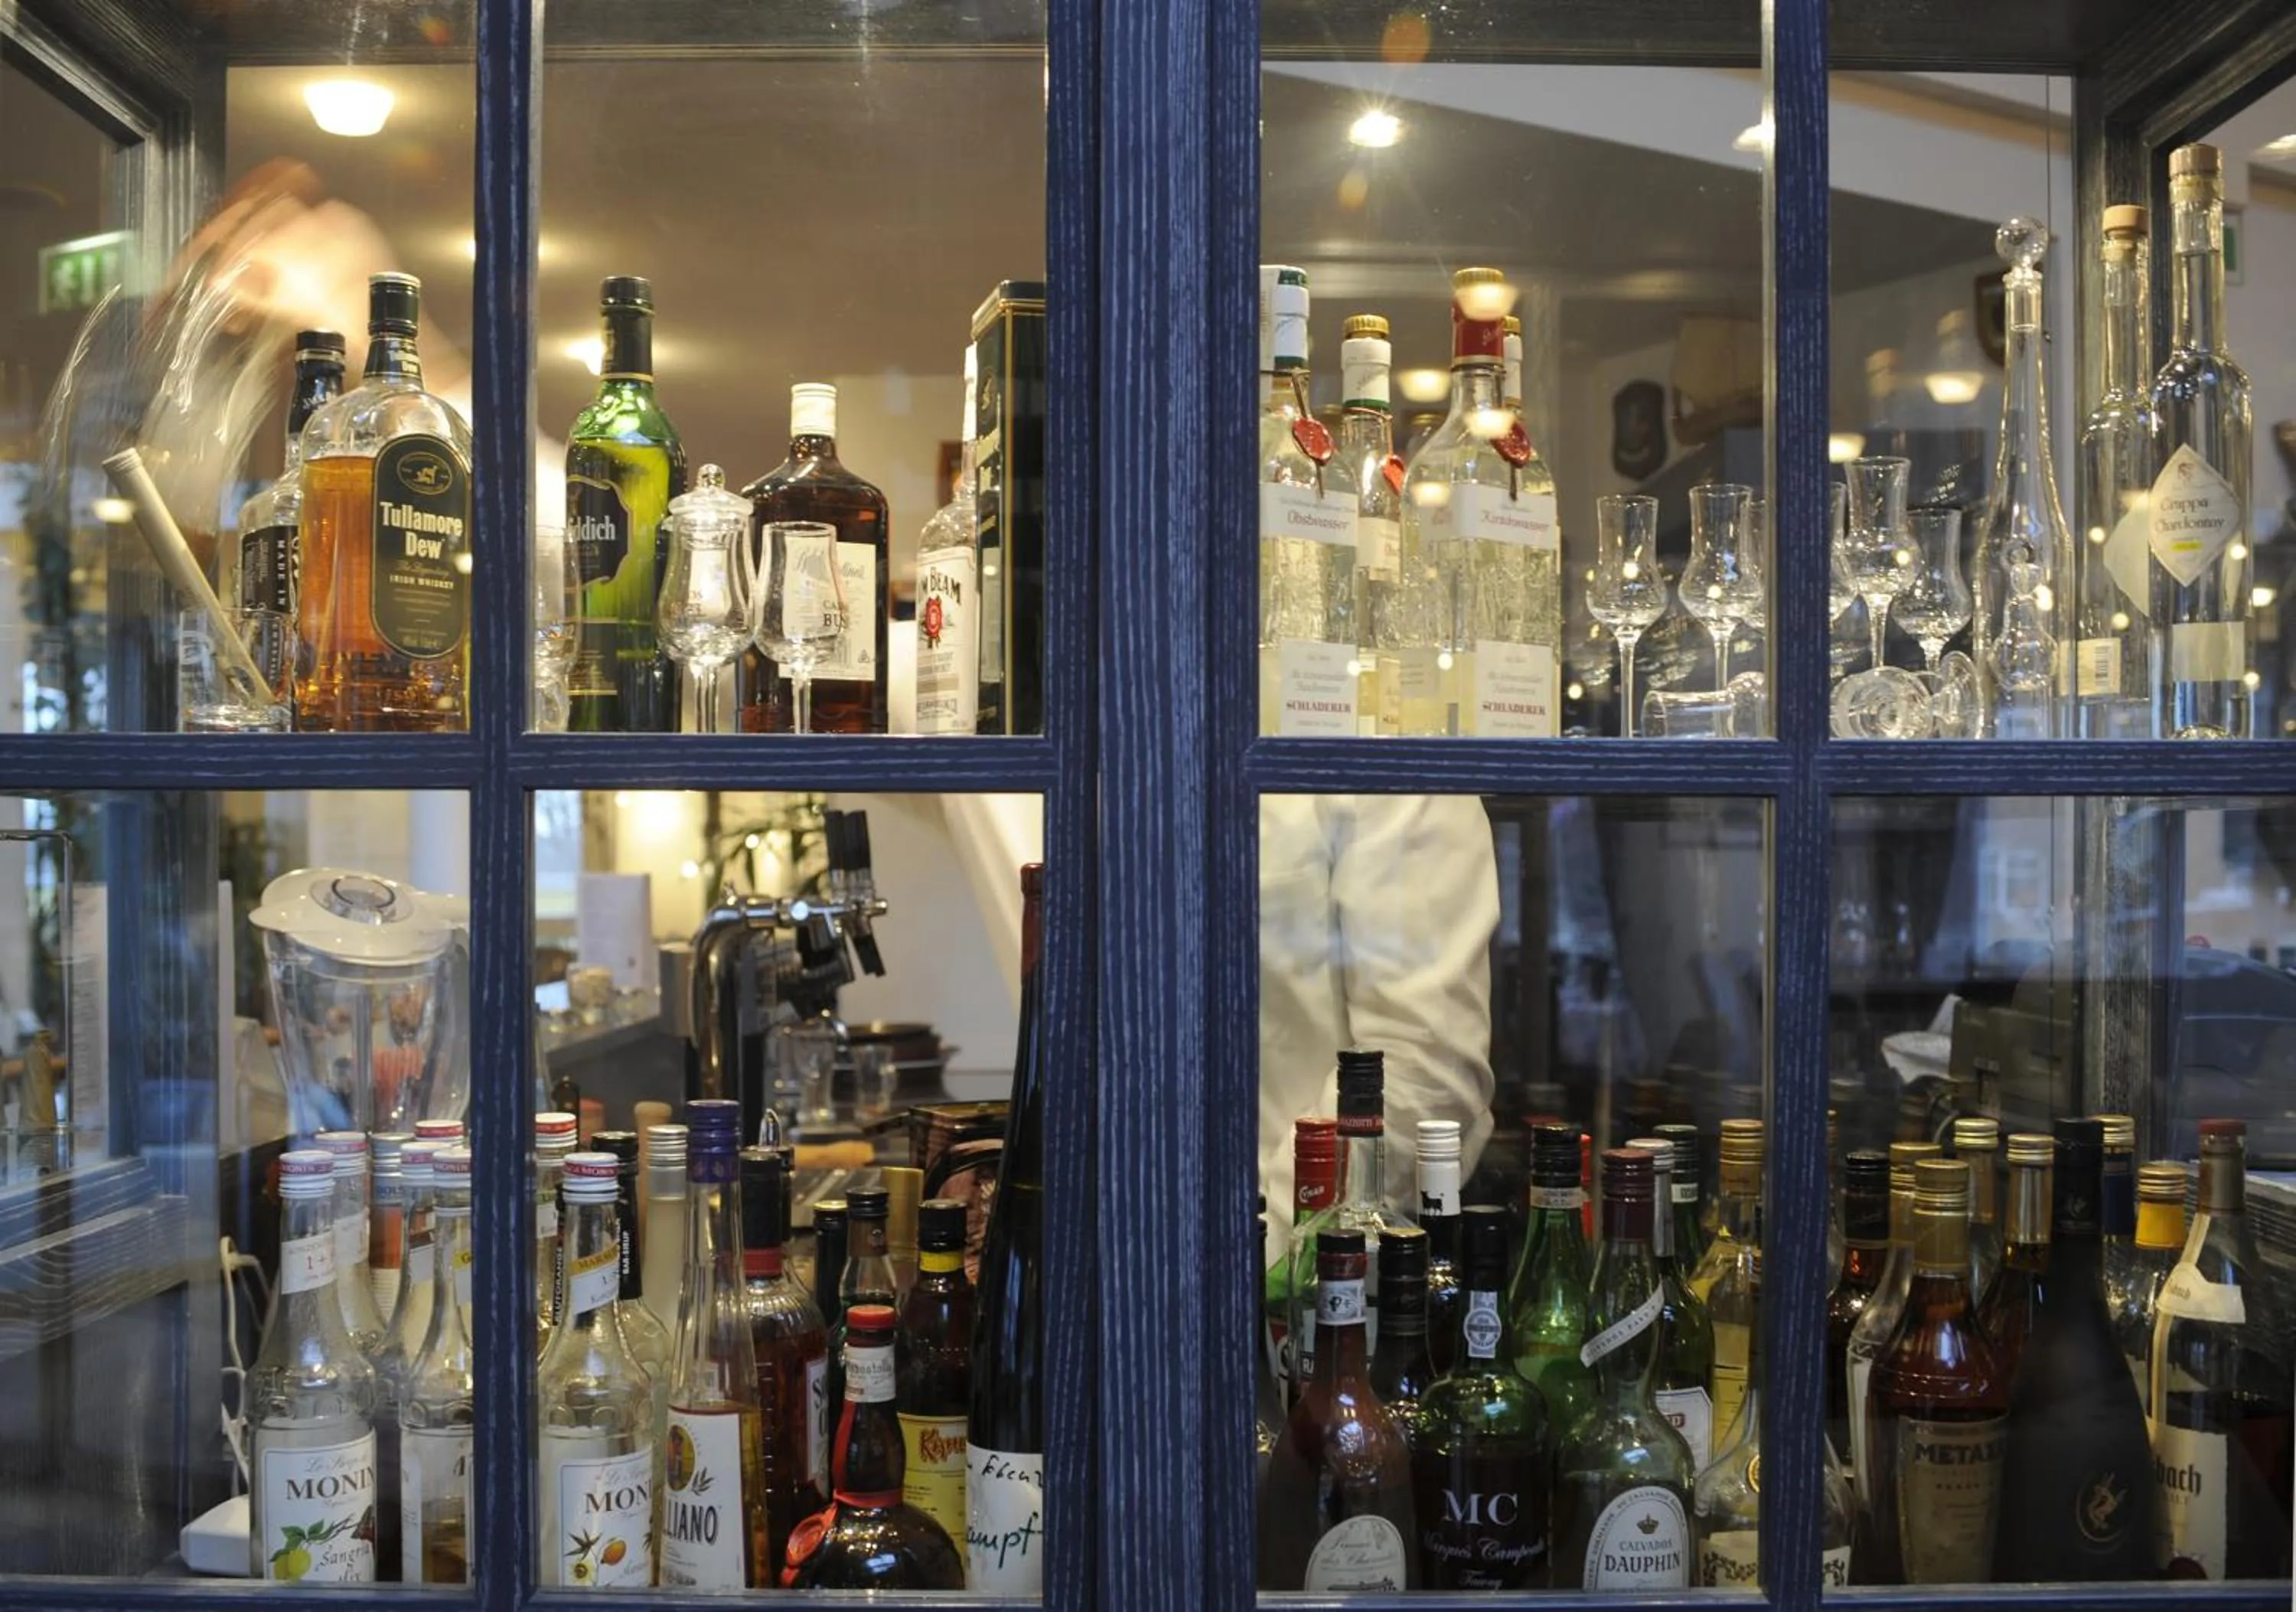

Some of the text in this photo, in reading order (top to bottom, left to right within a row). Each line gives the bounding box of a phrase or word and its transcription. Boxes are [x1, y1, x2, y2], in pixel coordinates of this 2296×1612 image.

[380, 501, 463, 537] Tullamore
[405, 531, 442, 560] Dew
[930, 566, 962, 607] BEAM
[1441, 1489, 1518, 1527] MC
[1619, 1537, 1674, 1552] CALVADOS
[1604, 1551, 1681, 1574] DAUPHIN
